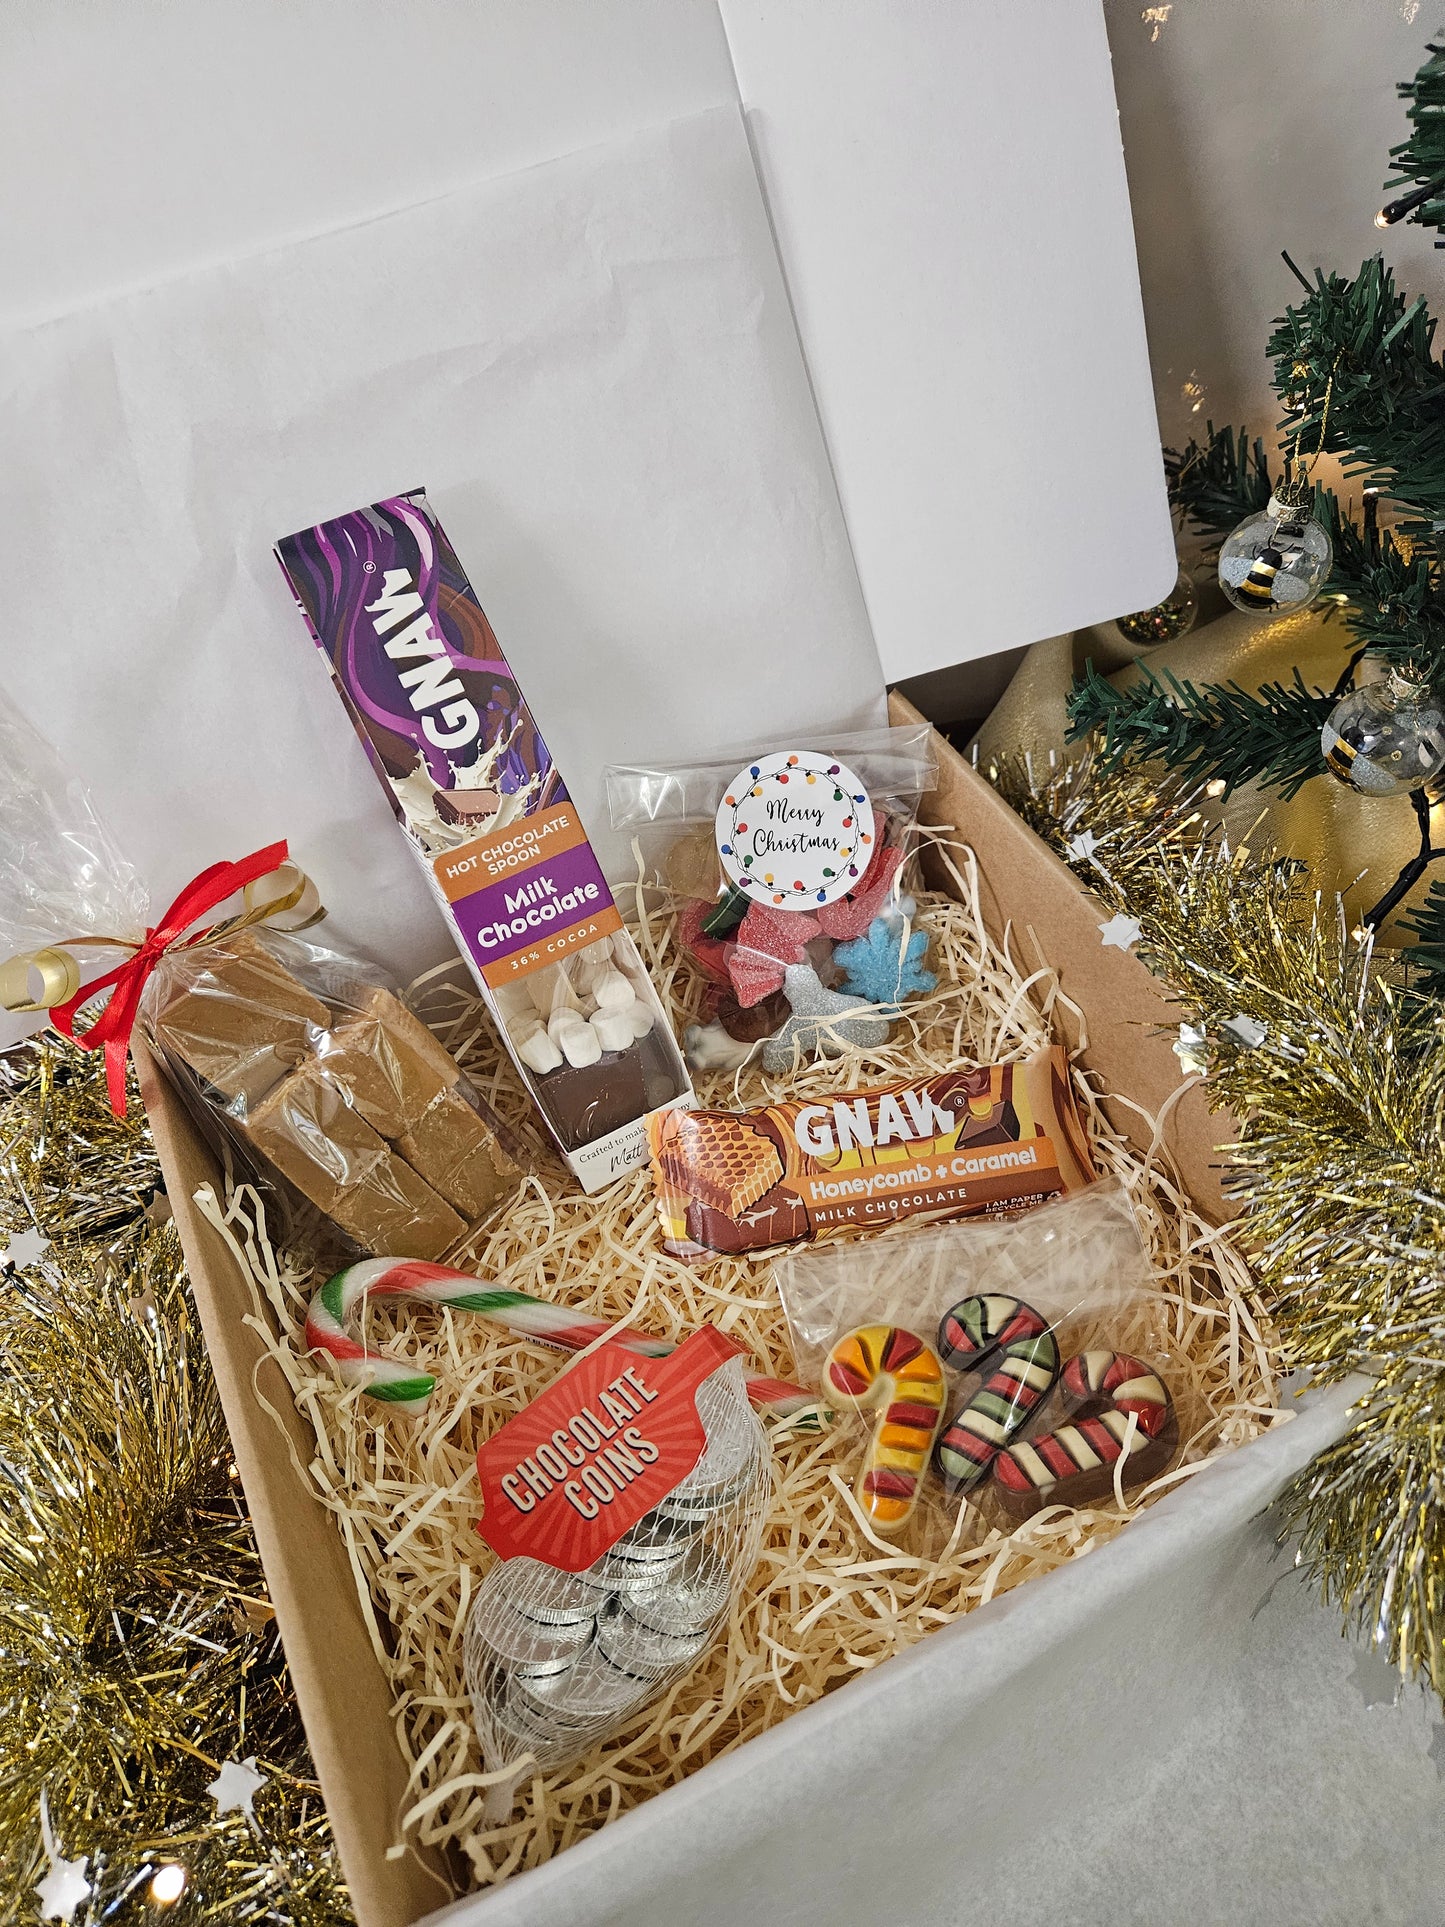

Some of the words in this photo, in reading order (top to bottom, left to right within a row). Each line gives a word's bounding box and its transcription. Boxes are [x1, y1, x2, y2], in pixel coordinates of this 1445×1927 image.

[365, 567, 480, 750] GNAW
[767, 798, 825, 827] Merry
[446, 856, 477, 878] HOT
[481, 816, 570, 862] CHOCOLATE
[488, 844, 541, 875] SPOON
[753, 828, 840, 856] Christmas
[478, 883, 599, 948] Chocolate
[504, 876, 558, 914] Milk
[511, 952, 540, 969] 36%
[547, 924, 598, 952] COCOA
[795, 1088, 955, 1156] GNAW
[579, 1142, 614, 1163] Crafted
[615, 1138, 624, 1146] to
[809, 1164, 932, 1200] Honeycomb
[951, 1146, 1037, 1177] Caramel
[815, 1206, 857, 1222] MILK
[866, 1188, 967, 1214] CHOCOLATE
[985, 1202, 1027, 1213] RECYCLE
[992, 1199, 1008, 1207] AM
[1011, 1193, 1043, 1203] PAPER
[501, 1366, 659, 1513] CHOCOLATE
[564, 1426, 660, 1520] COINS
